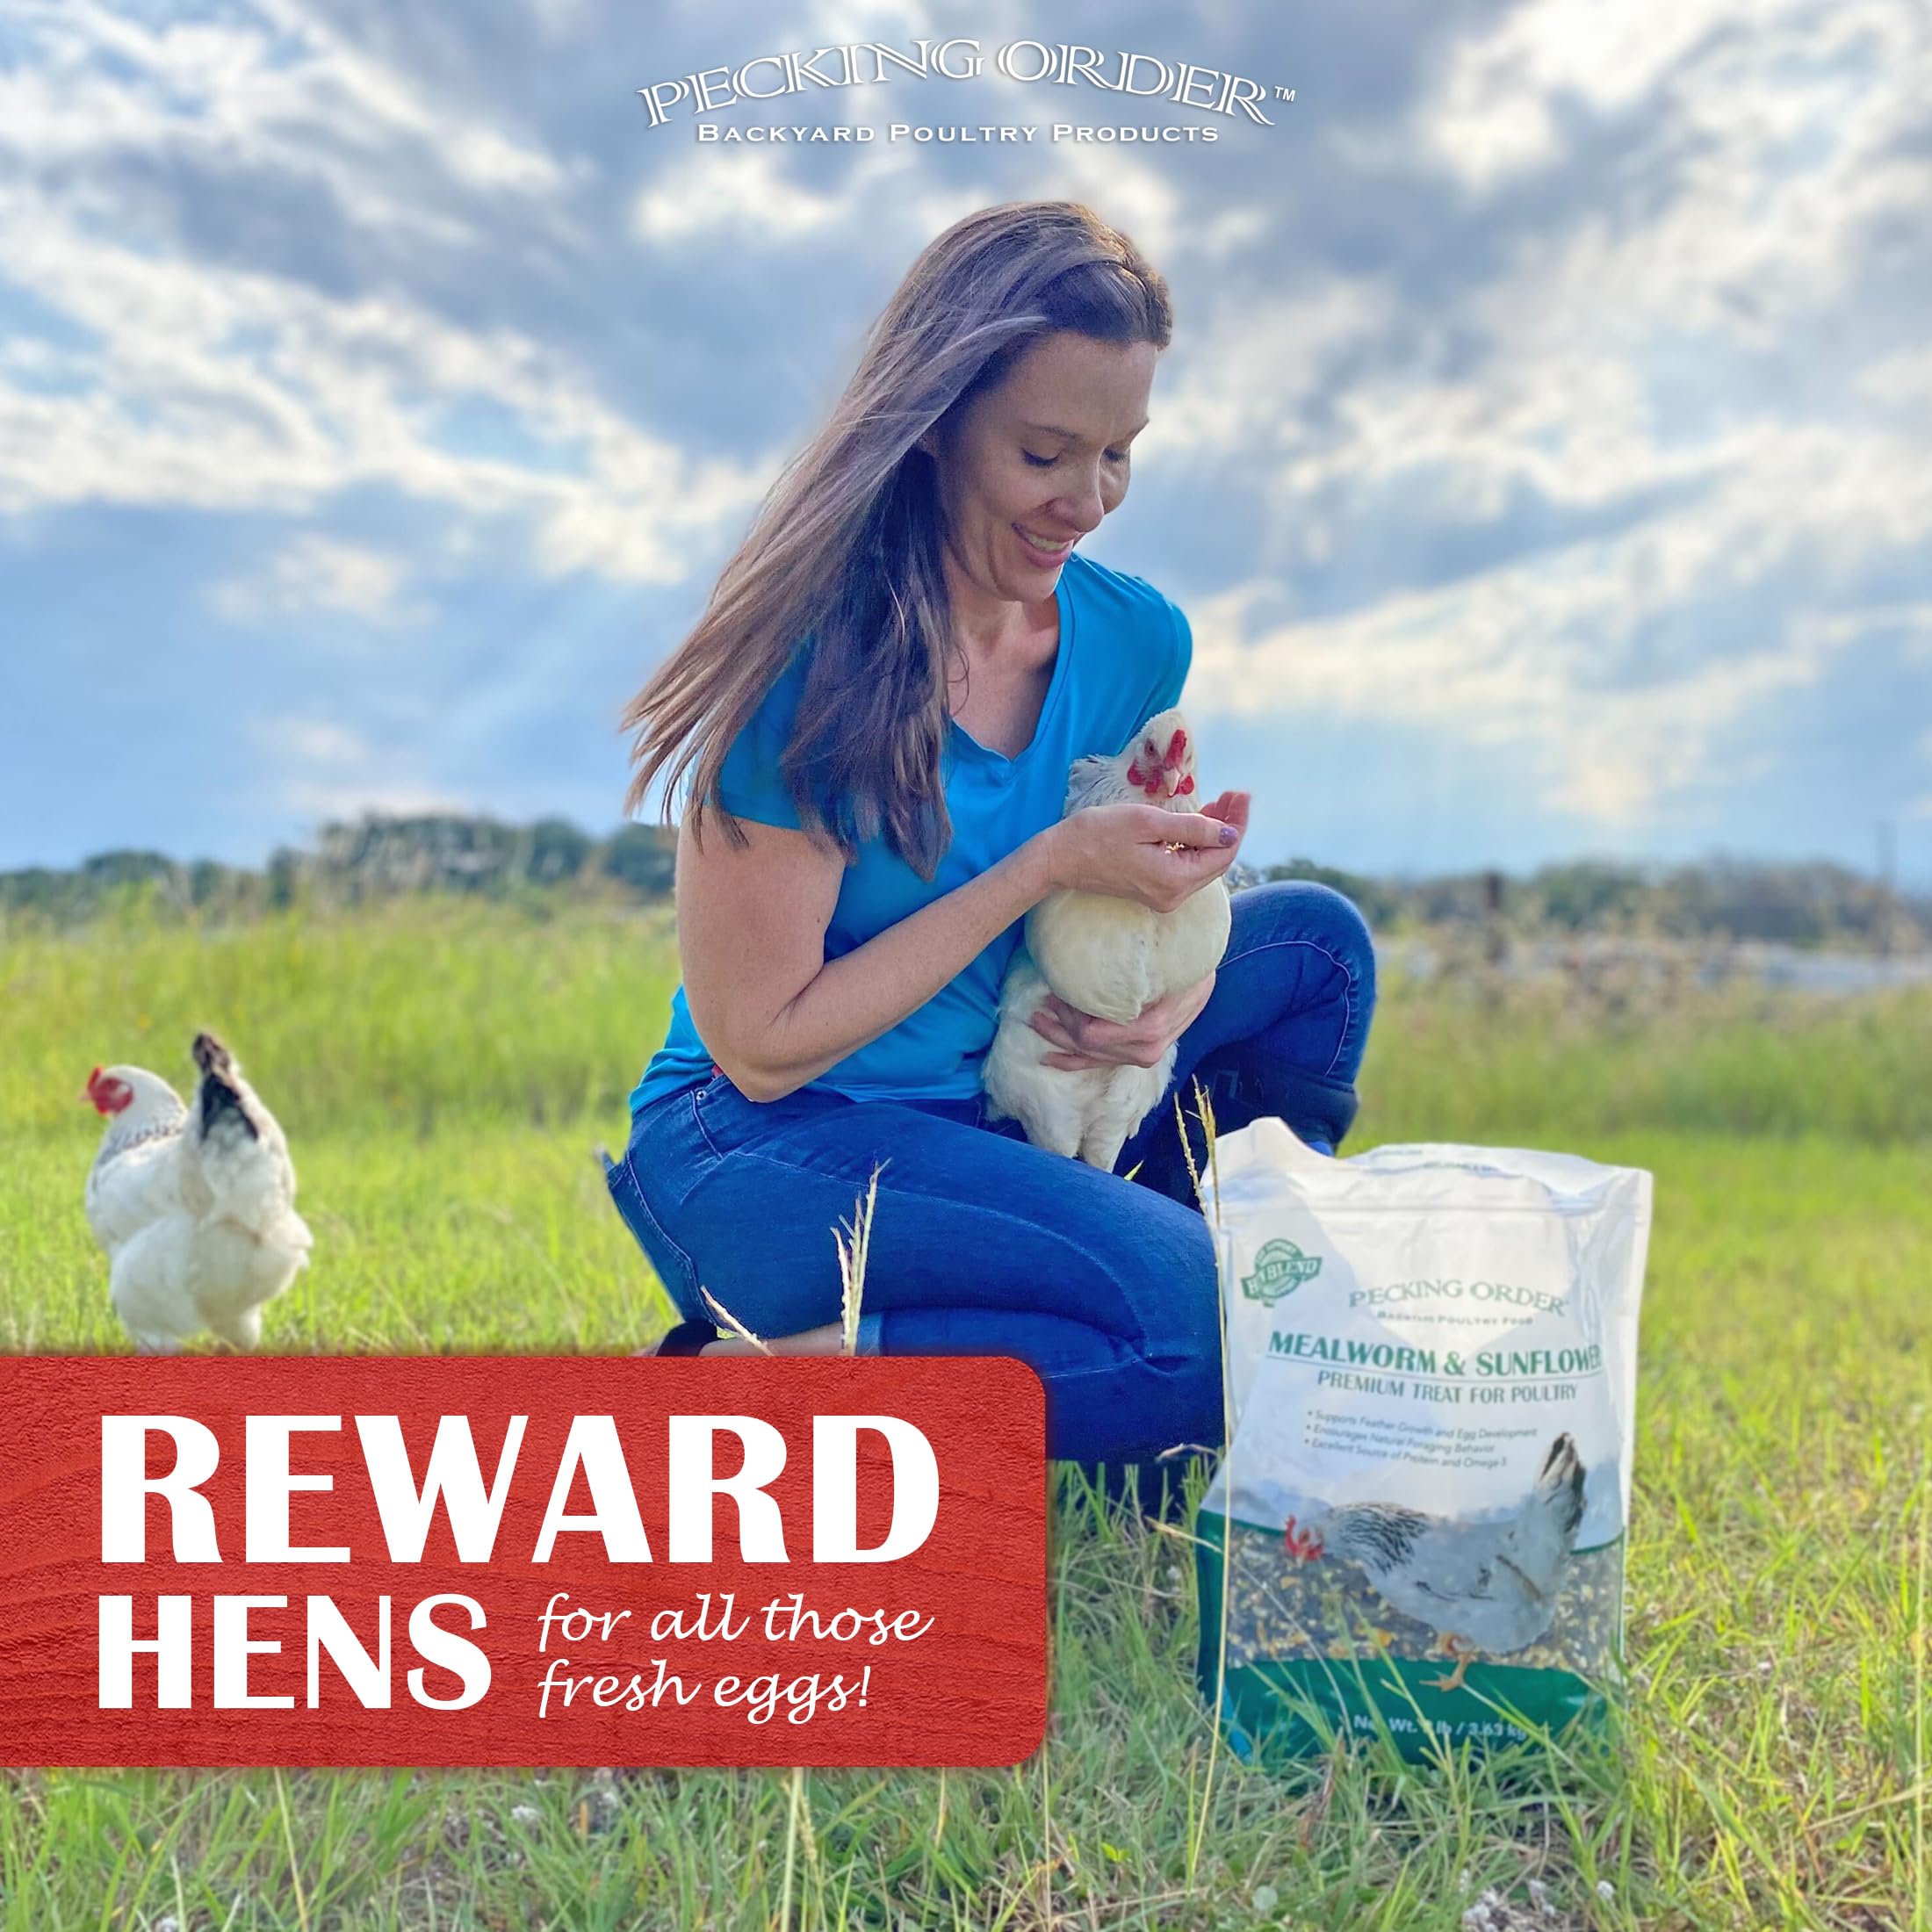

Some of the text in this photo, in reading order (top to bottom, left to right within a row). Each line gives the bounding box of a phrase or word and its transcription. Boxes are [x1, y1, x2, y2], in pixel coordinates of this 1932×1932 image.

[1349, 1280, 1565, 1317] PECKING ORDER
[1269, 1330, 1437, 1374] MEALWORM
[1444, 1351, 1466, 1376] &
[1317, 1369, 1578, 1404] PREMIUM TREAT FOR POULTRY
[1314, 1424, 1495, 1454] Encourages Natural Foraging Behavior
[1316, 1409, 1538, 1441] Supports Feather Growth and Egg Development
[1312, 1438, 1354, 1453] Excellent
[1356, 1444, 1388, 1458] Source
[1391, 1450, 1402, 1460] of
[1403, 1452, 1438, 1465] Protein
[1441, 1458, 1461, 1467] and
[1388, 1717, 1417, 1734] Wt.
